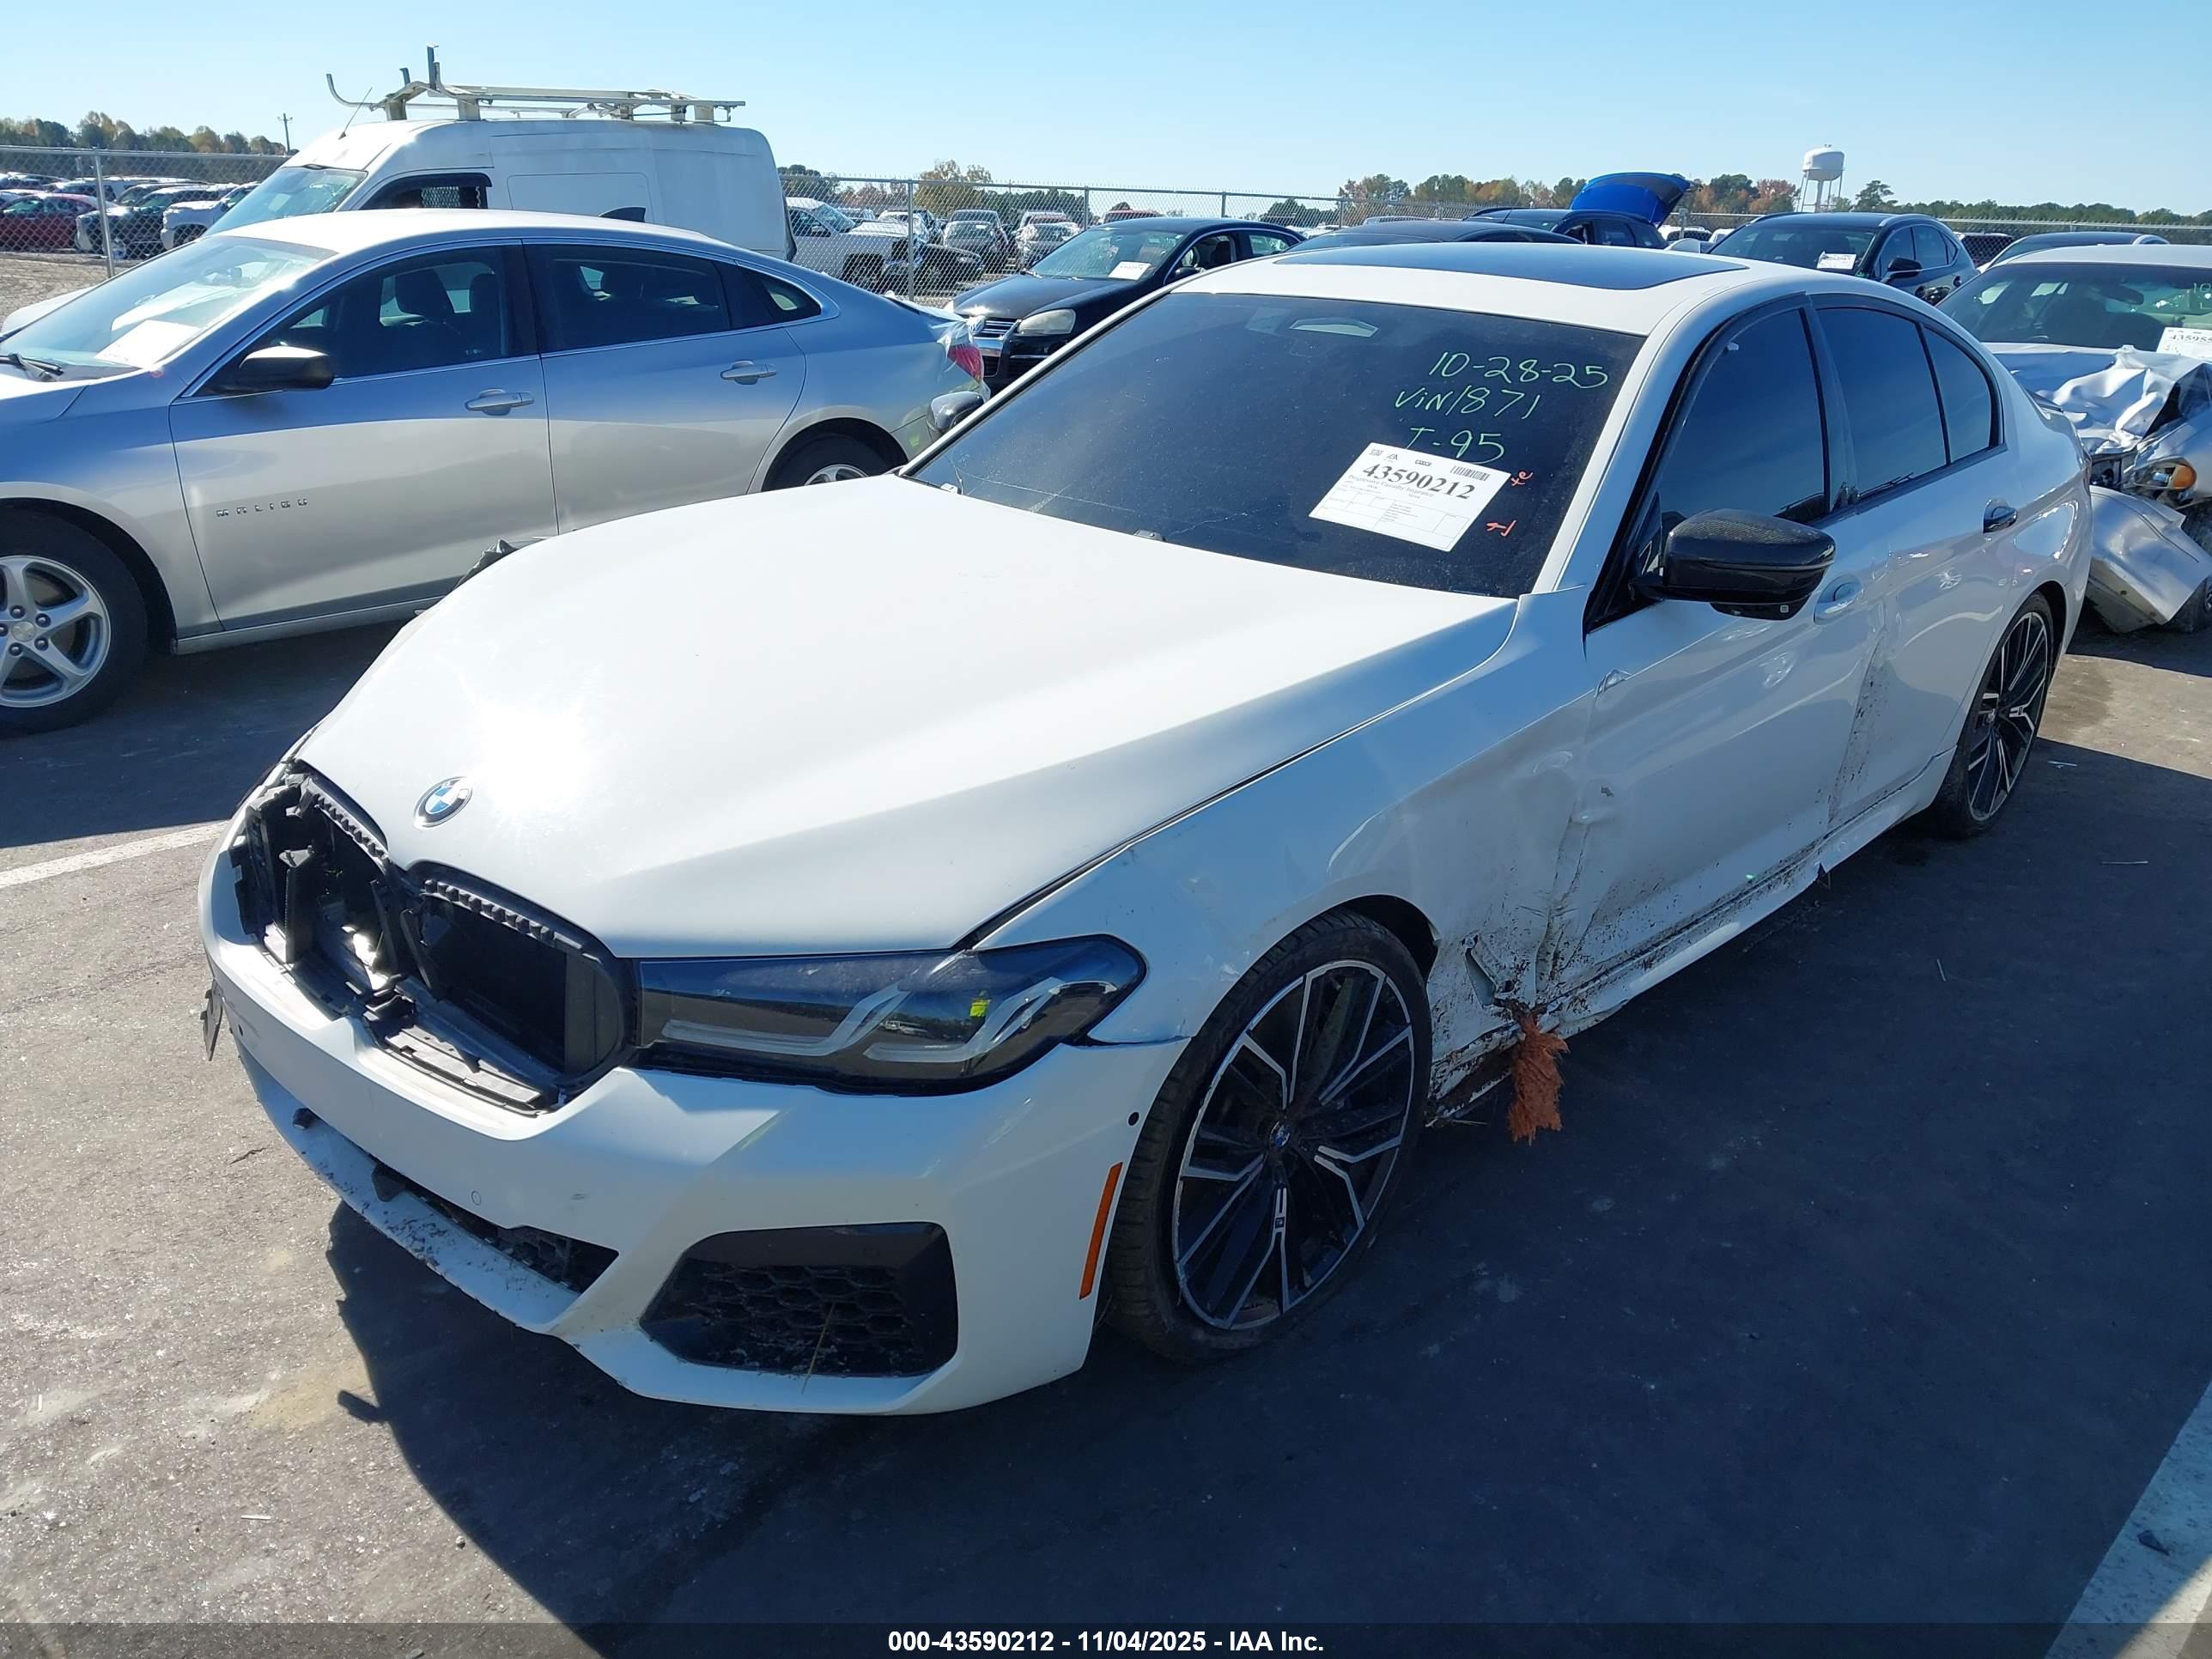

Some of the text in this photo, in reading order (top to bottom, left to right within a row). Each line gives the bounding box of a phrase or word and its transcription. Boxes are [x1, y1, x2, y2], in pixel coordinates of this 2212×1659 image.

[1428, 351, 1609, 389] 10-28-25
[1405, 427, 1505, 465] T-95
[1363, 464, 1476, 500] 43590212
[216, 498, 307, 518] MALIBU
